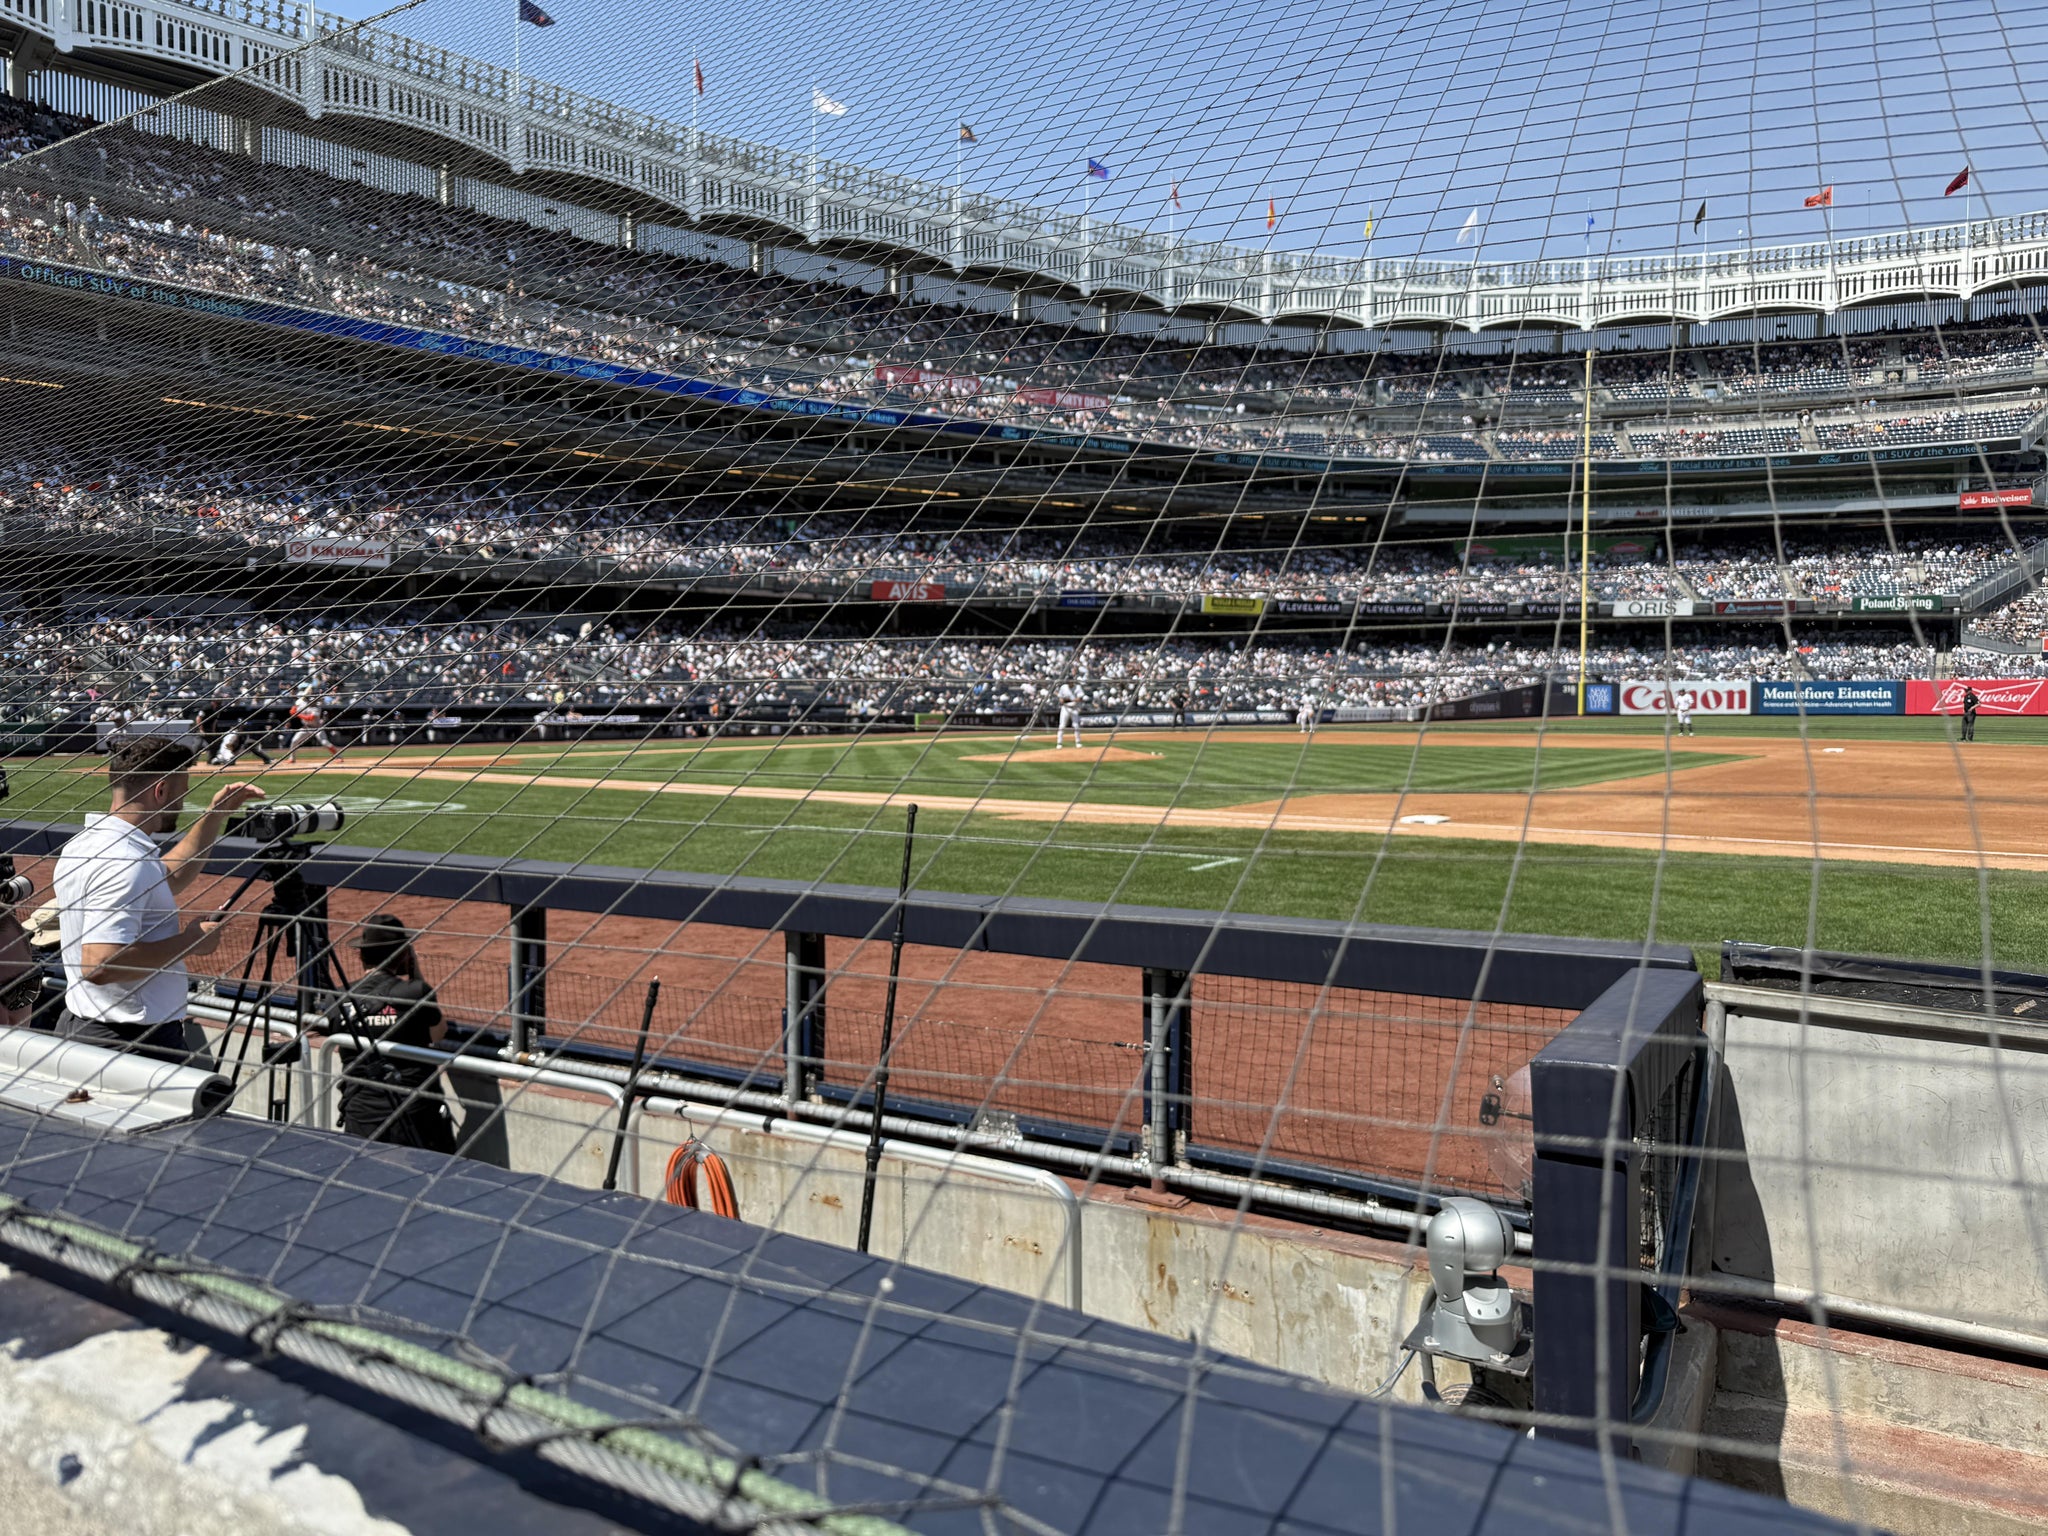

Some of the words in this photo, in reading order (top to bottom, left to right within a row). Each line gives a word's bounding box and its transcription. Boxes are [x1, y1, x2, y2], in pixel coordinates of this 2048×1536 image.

[89, 276, 125, 295] SUV
[130, 285, 146, 298] of
[152, 289, 178, 305] the
[1818, 454, 1841, 464] Ford
[1852, 450, 1888, 462] Offiial
[1890, 450, 1911, 459] SUV
[1913, 448, 1925, 458] of
[1927, 447, 1944, 457] the
[1703, 459, 1723, 469] SUV
[1724, 459, 1734, 468] of
[1735, 458, 1751, 468] the
[1981, 493, 2029, 504] Budweiser
[311, 545, 385, 560] KIKKOMAN
[888, 582, 928, 600] AVIS
[1286, 602, 1341, 613] LEVELWEAR
[1366, 603, 1424, 614] LEVELWEAR
[1628, 601, 1677, 616] ORIS
[1860, 597, 1897, 611] Poland
[1897, 596, 1934, 611] Spring
[1587, 694, 1611, 702] YORK
[1589, 687, 1608, 696] NEW
[1763, 687, 1835, 700] Montefiore
[1837, 687, 1892, 699] Einstein
[1941, 687, 2031, 704] Bdweiser
[1589, 700, 1608, 709] LIFE
